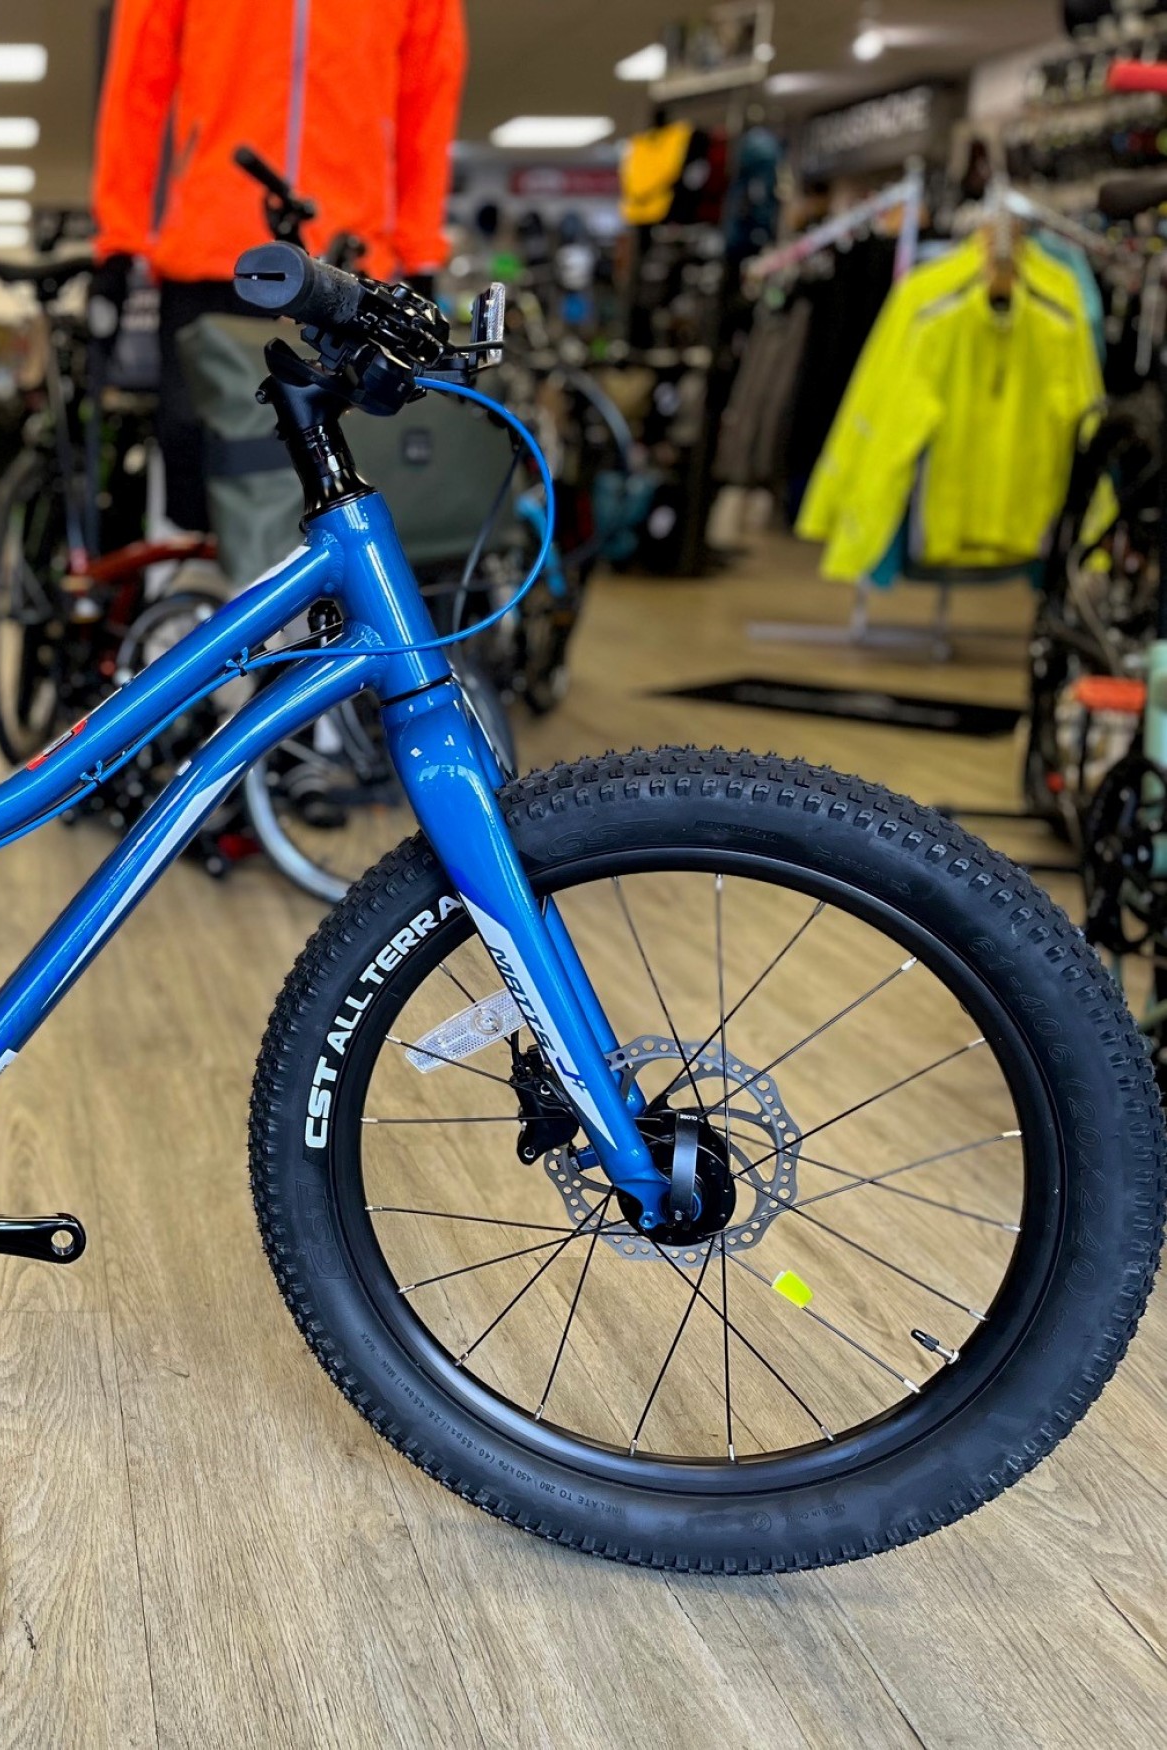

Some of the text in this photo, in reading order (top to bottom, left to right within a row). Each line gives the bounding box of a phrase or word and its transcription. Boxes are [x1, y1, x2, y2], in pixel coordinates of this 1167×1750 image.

[305, 895, 462, 1149] CST ALL TERRA
